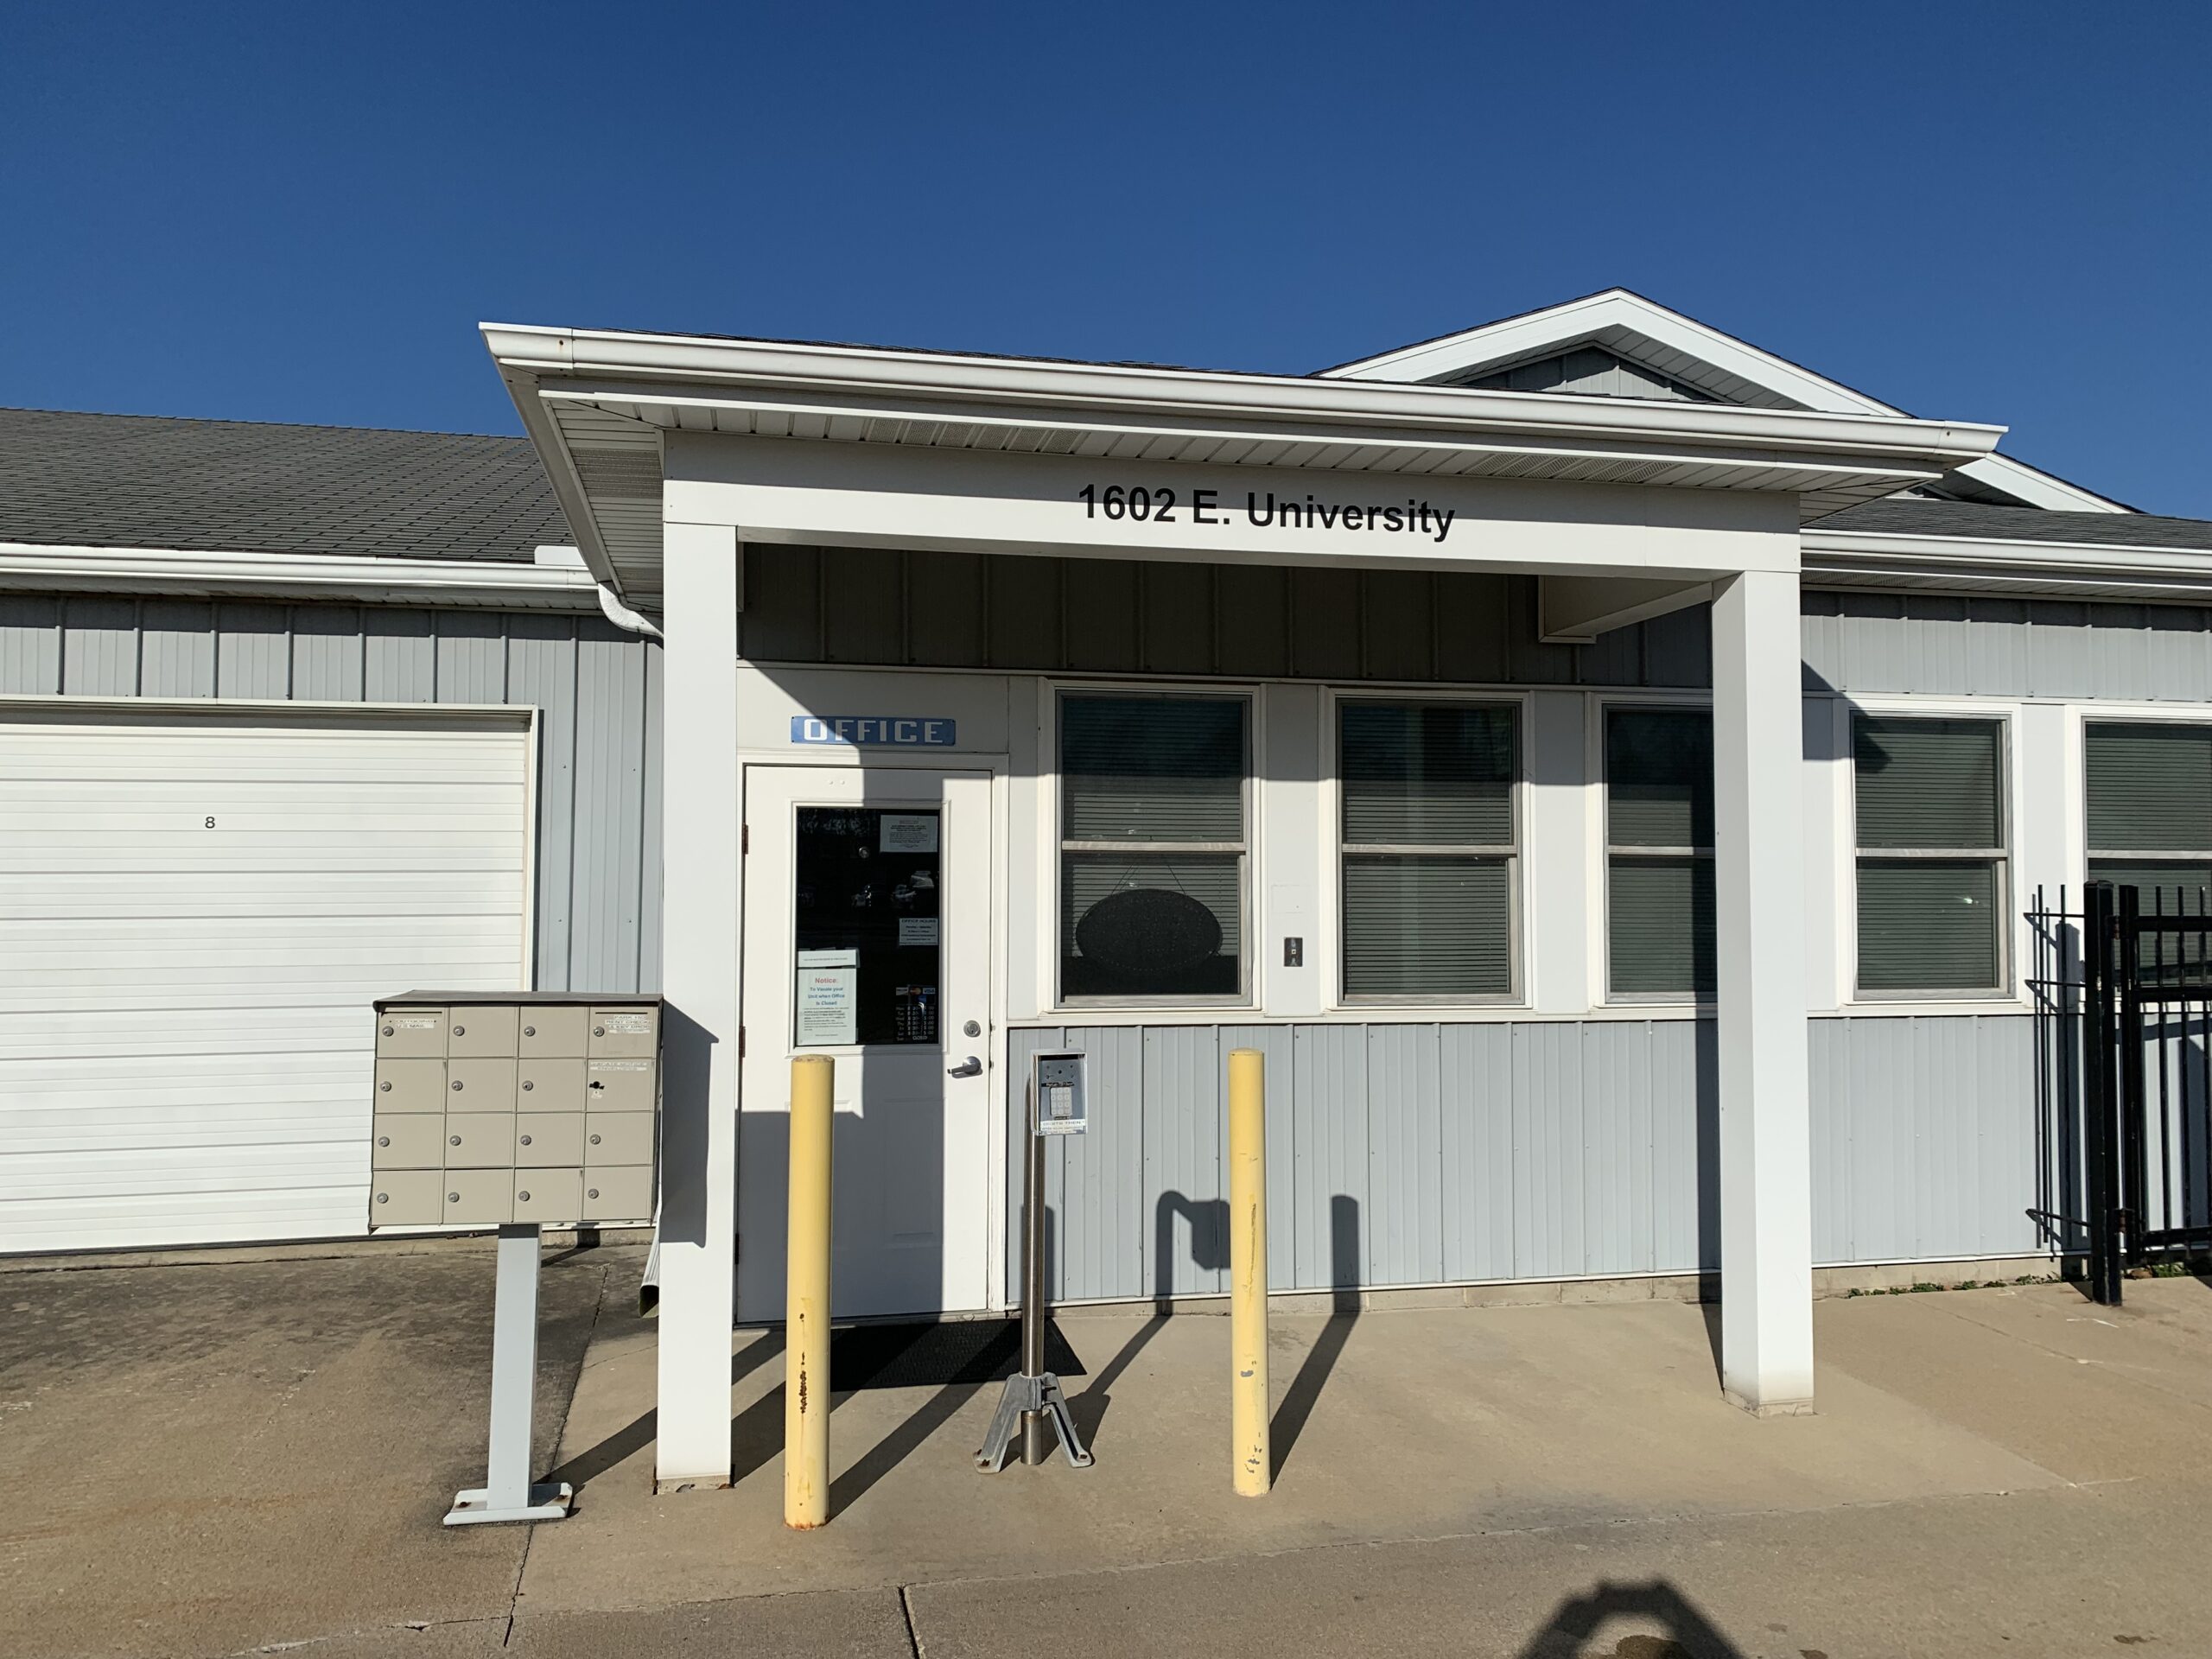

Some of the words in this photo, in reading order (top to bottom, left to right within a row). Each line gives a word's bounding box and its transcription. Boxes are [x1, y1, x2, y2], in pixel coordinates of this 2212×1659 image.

[1078, 484, 1176, 522] 1602
[1192, 489, 1230, 524] E.
[1247, 492, 1456, 543] University
[804, 718, 944, 743] OFFICE
[205, 816, 216, 829] 8
